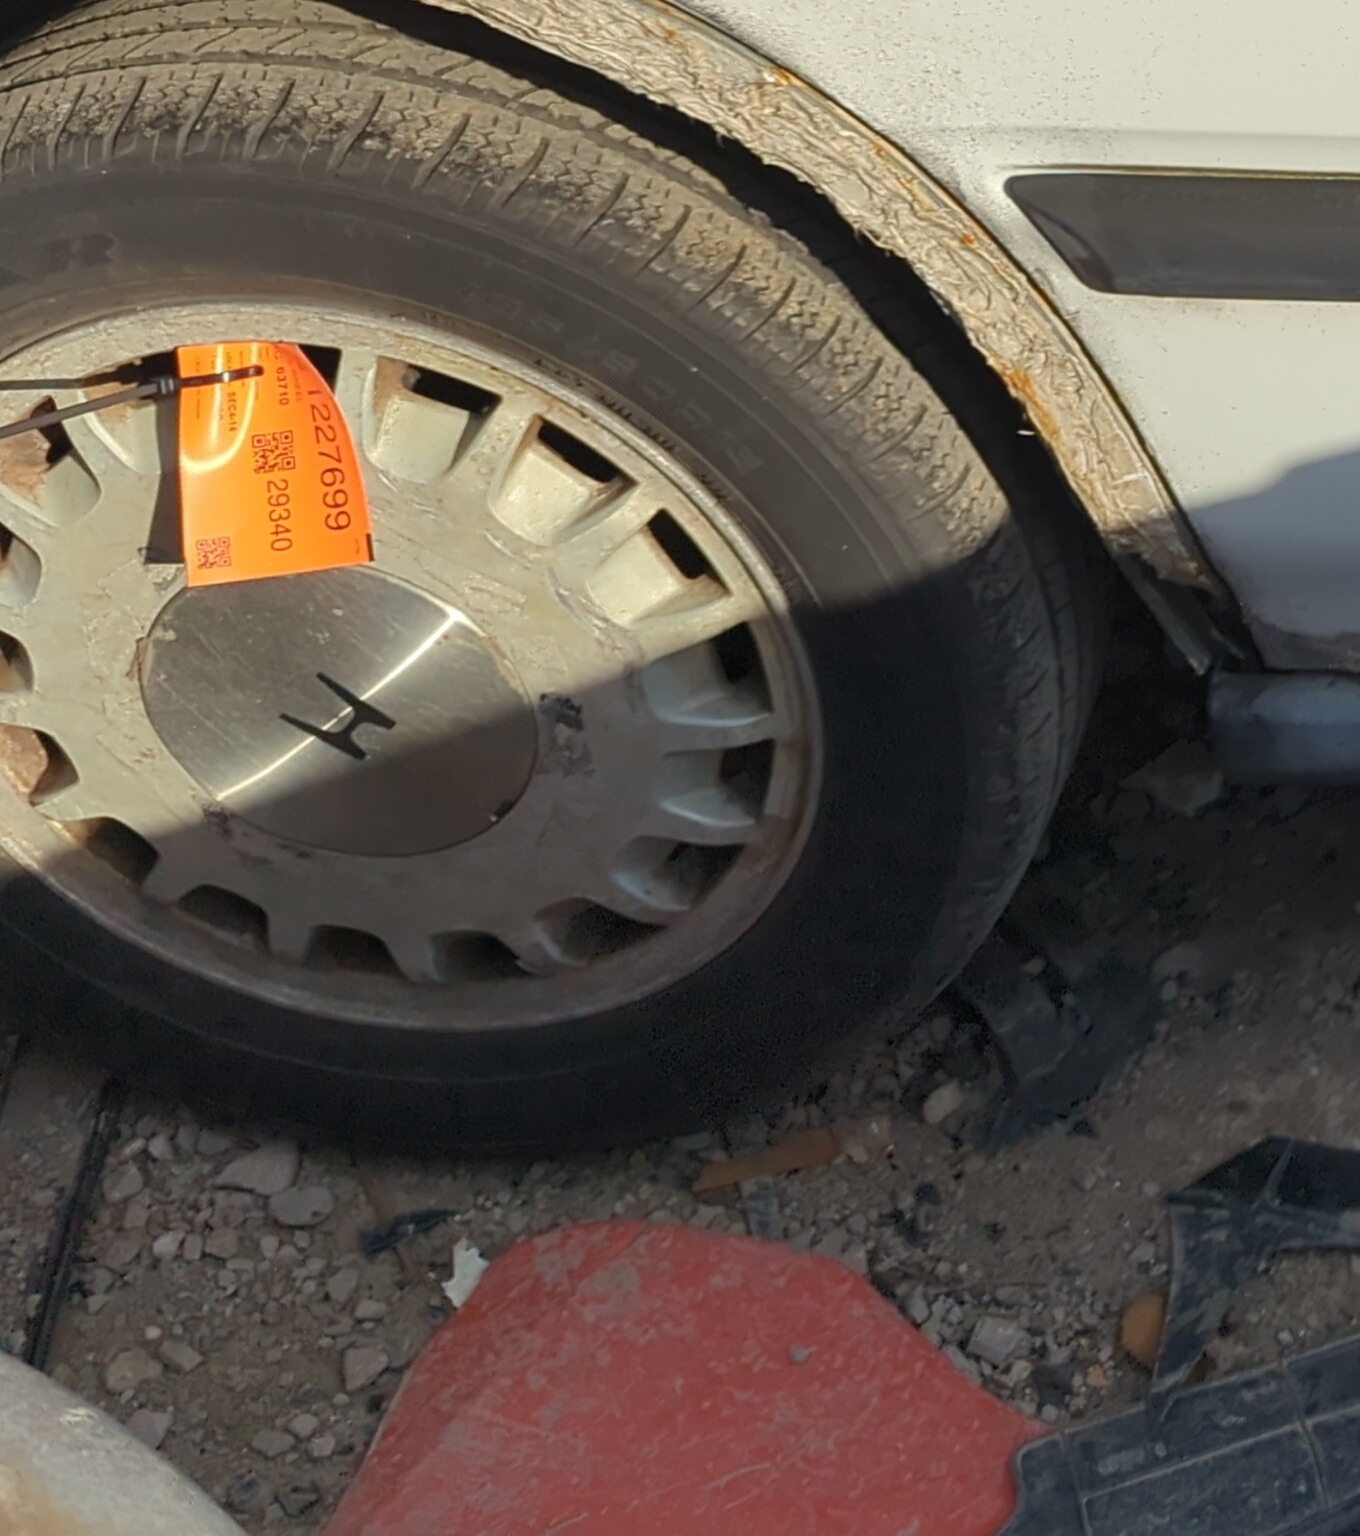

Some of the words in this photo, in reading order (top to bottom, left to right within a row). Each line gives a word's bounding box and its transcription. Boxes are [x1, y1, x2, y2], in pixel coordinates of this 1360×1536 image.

[275, 366, 290, 407] 63710
[307, 389, 351, 531] 1227699
[266, 478, 293, 553] 29340
